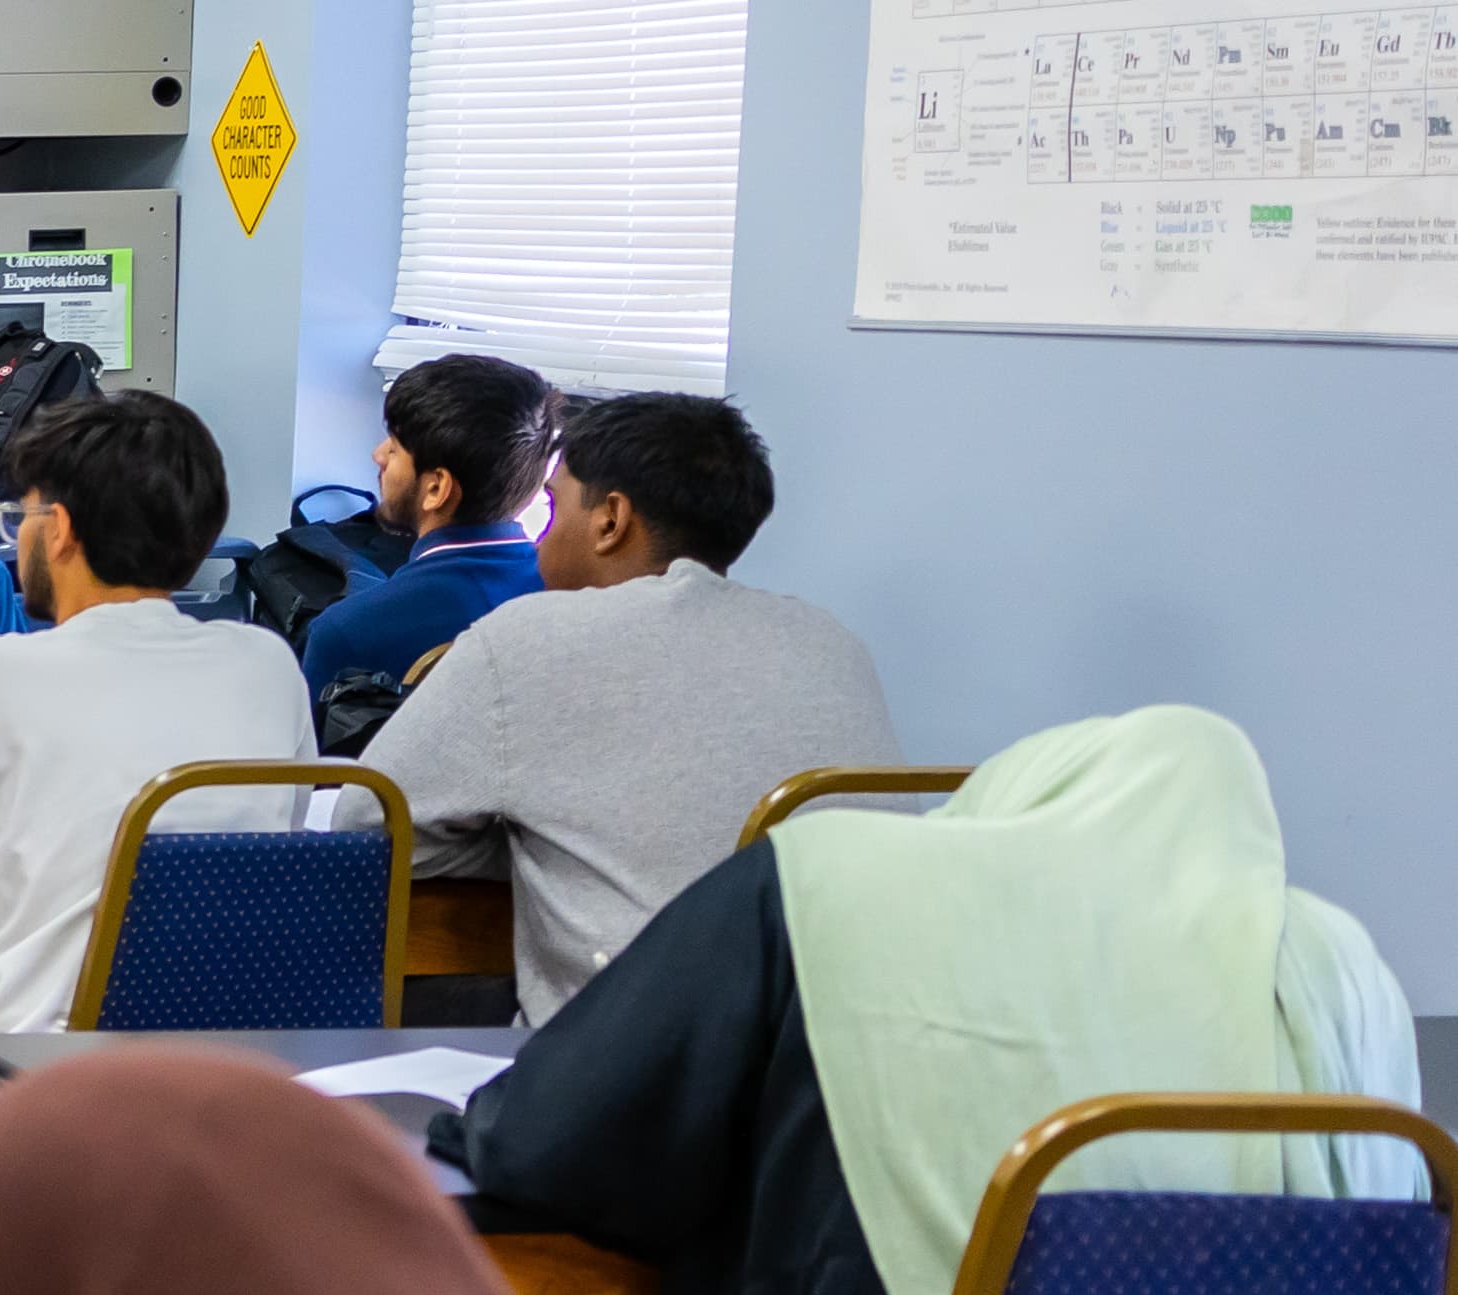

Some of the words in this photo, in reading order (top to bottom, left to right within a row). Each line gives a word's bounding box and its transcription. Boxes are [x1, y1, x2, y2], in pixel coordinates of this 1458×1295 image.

[1377, 34, 1401, 53] Gd
[1434, 31, 1456, 51] Tb
[1173, 48, 1191, 66] Nd
[1266, 43, 1289, 59] Sm
[1035, 58, 1052, 75] La
[1077, 55, 1095, 73] Ce
[1124, 52, 1140, 70] Pr
[240, 95, 266, 120] GOOD
[918, 91, 939, 121] Li
[223, 125, 282, 150] CHARACTER
[1073, 130, 1090, 148] Th
[1118, 128, 1134, 145] Pa
[1164, 126, 1176, 144] U
[230, 155, 271, 180] COUNTS
[5, 254, 107, 268] Chromebook
[2, 271, 108, 291] Expectations
